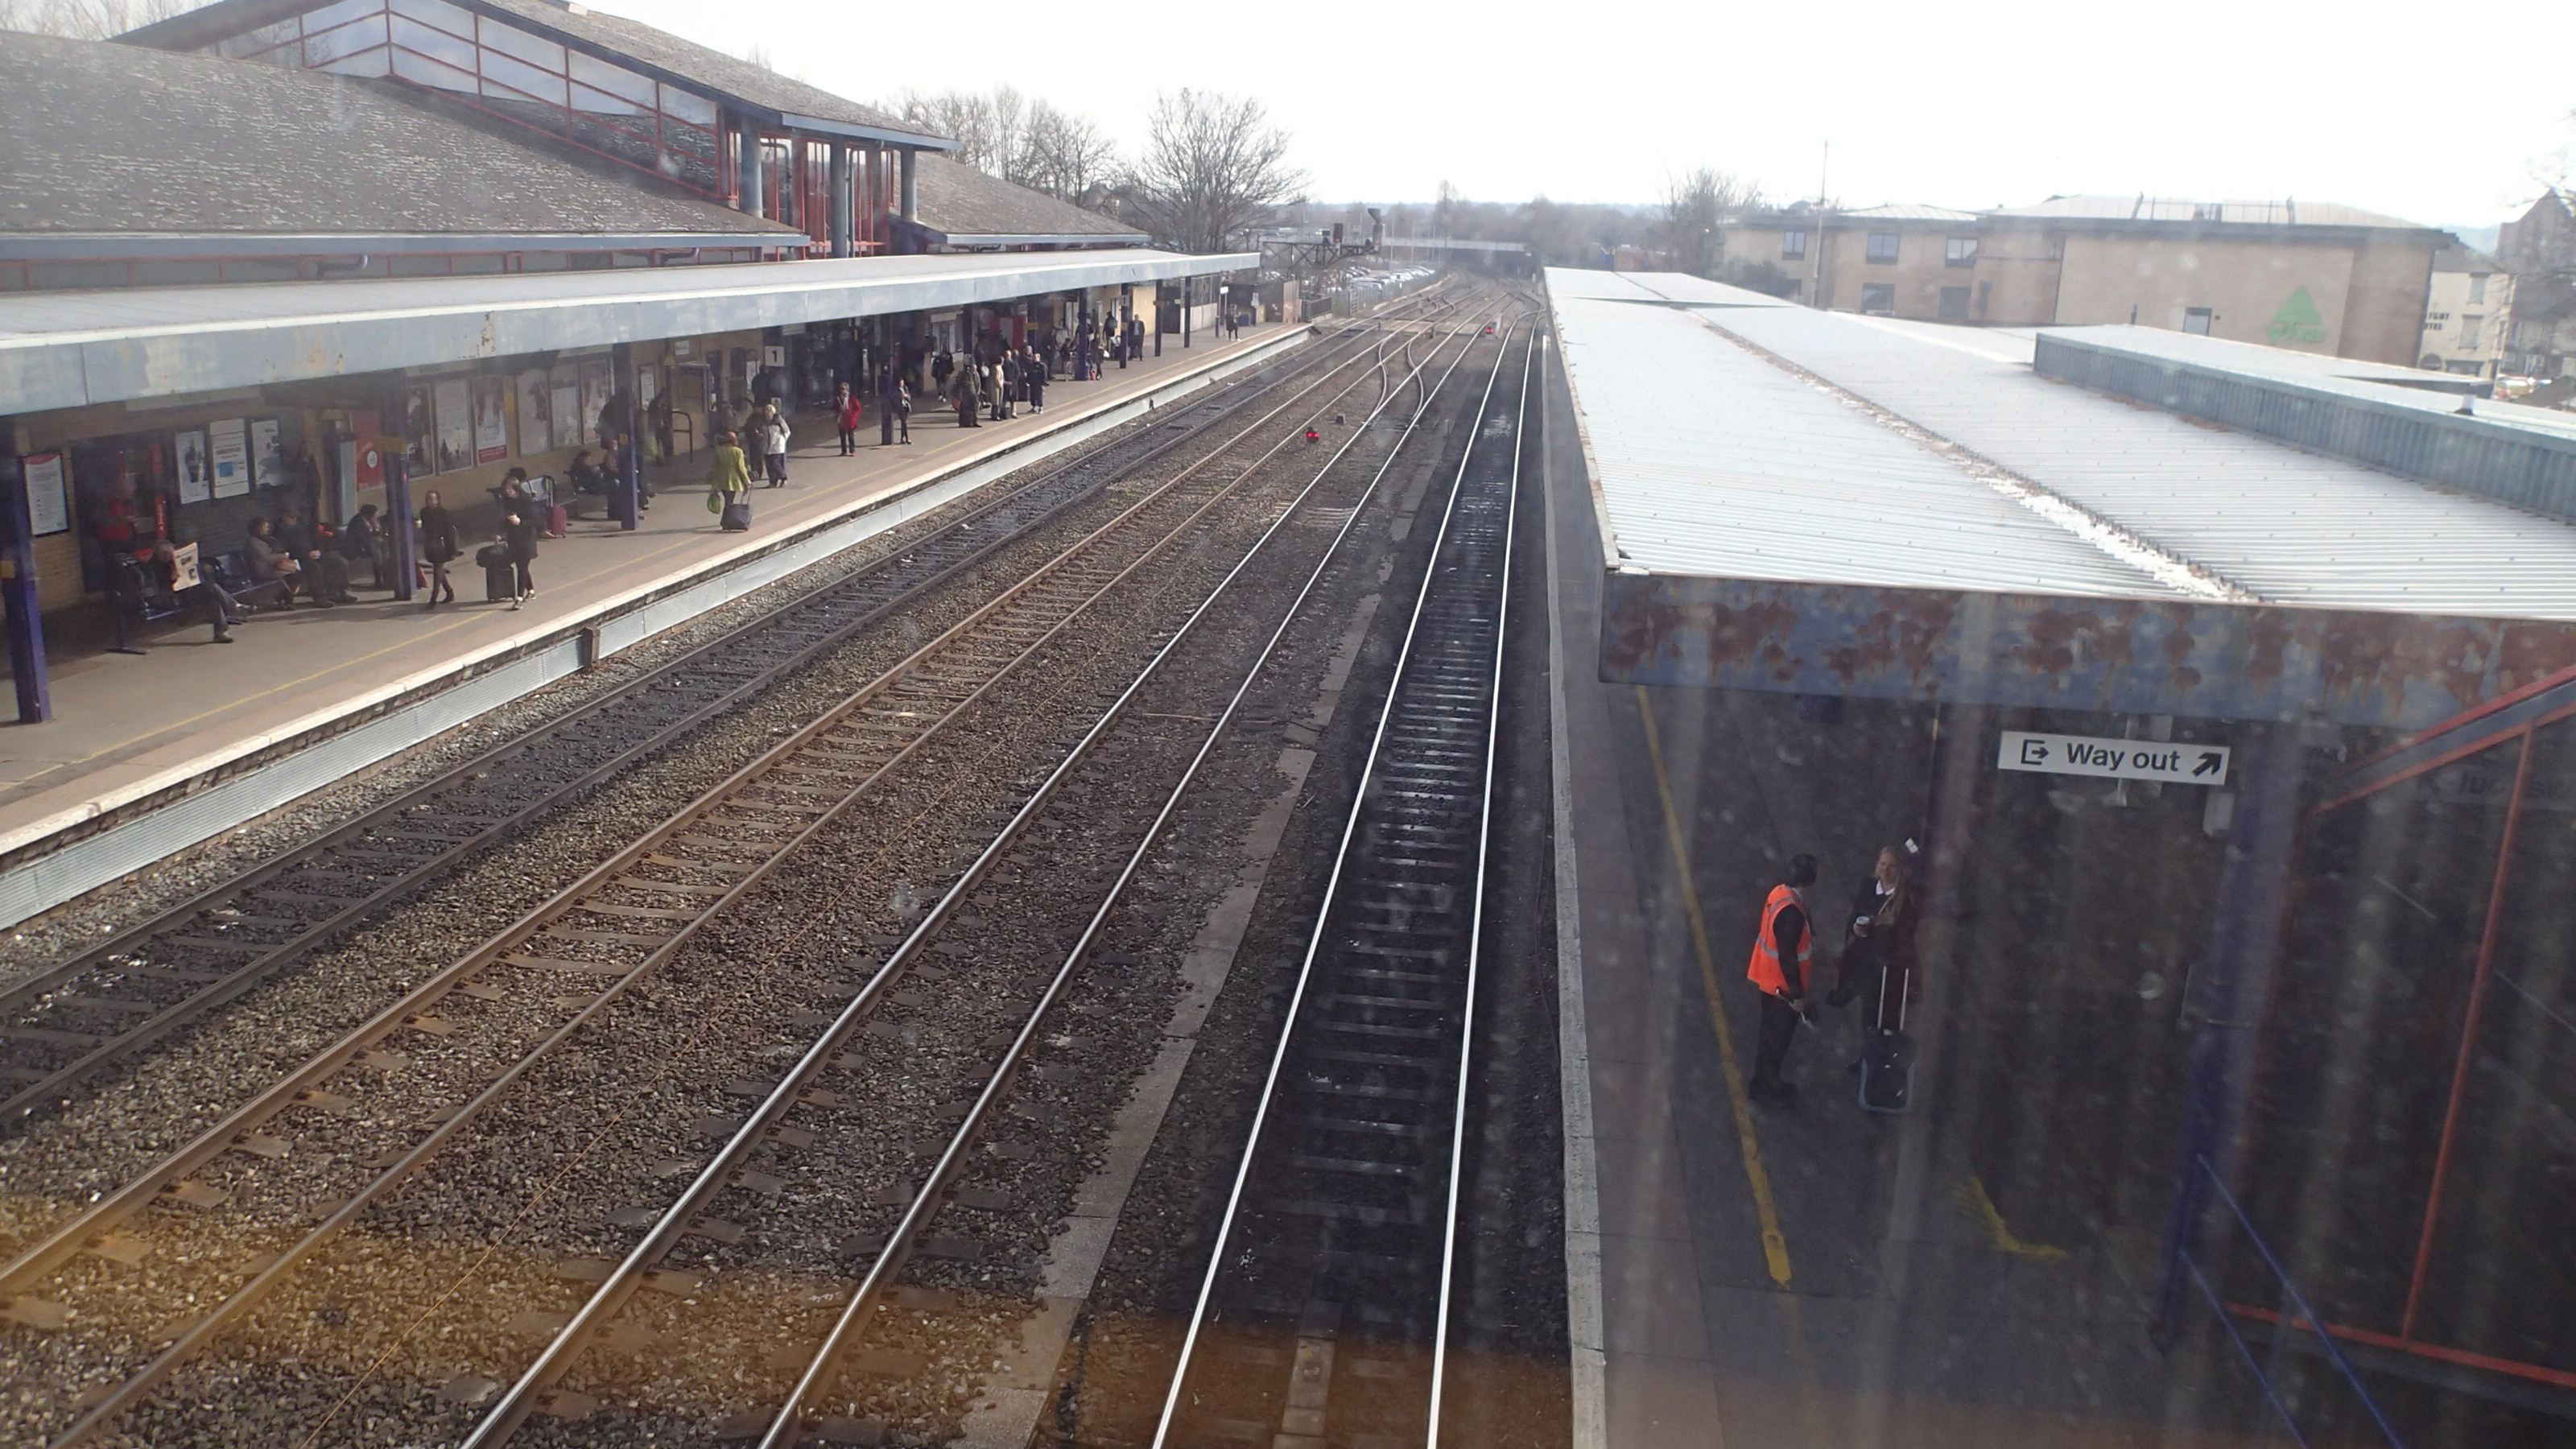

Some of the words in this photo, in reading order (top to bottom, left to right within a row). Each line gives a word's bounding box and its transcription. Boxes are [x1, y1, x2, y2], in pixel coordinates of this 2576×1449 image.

[771, 349, 778, 363] 1
[2066, 741, 2125, 771] Way
[2132, 750, 2181, 772] out
